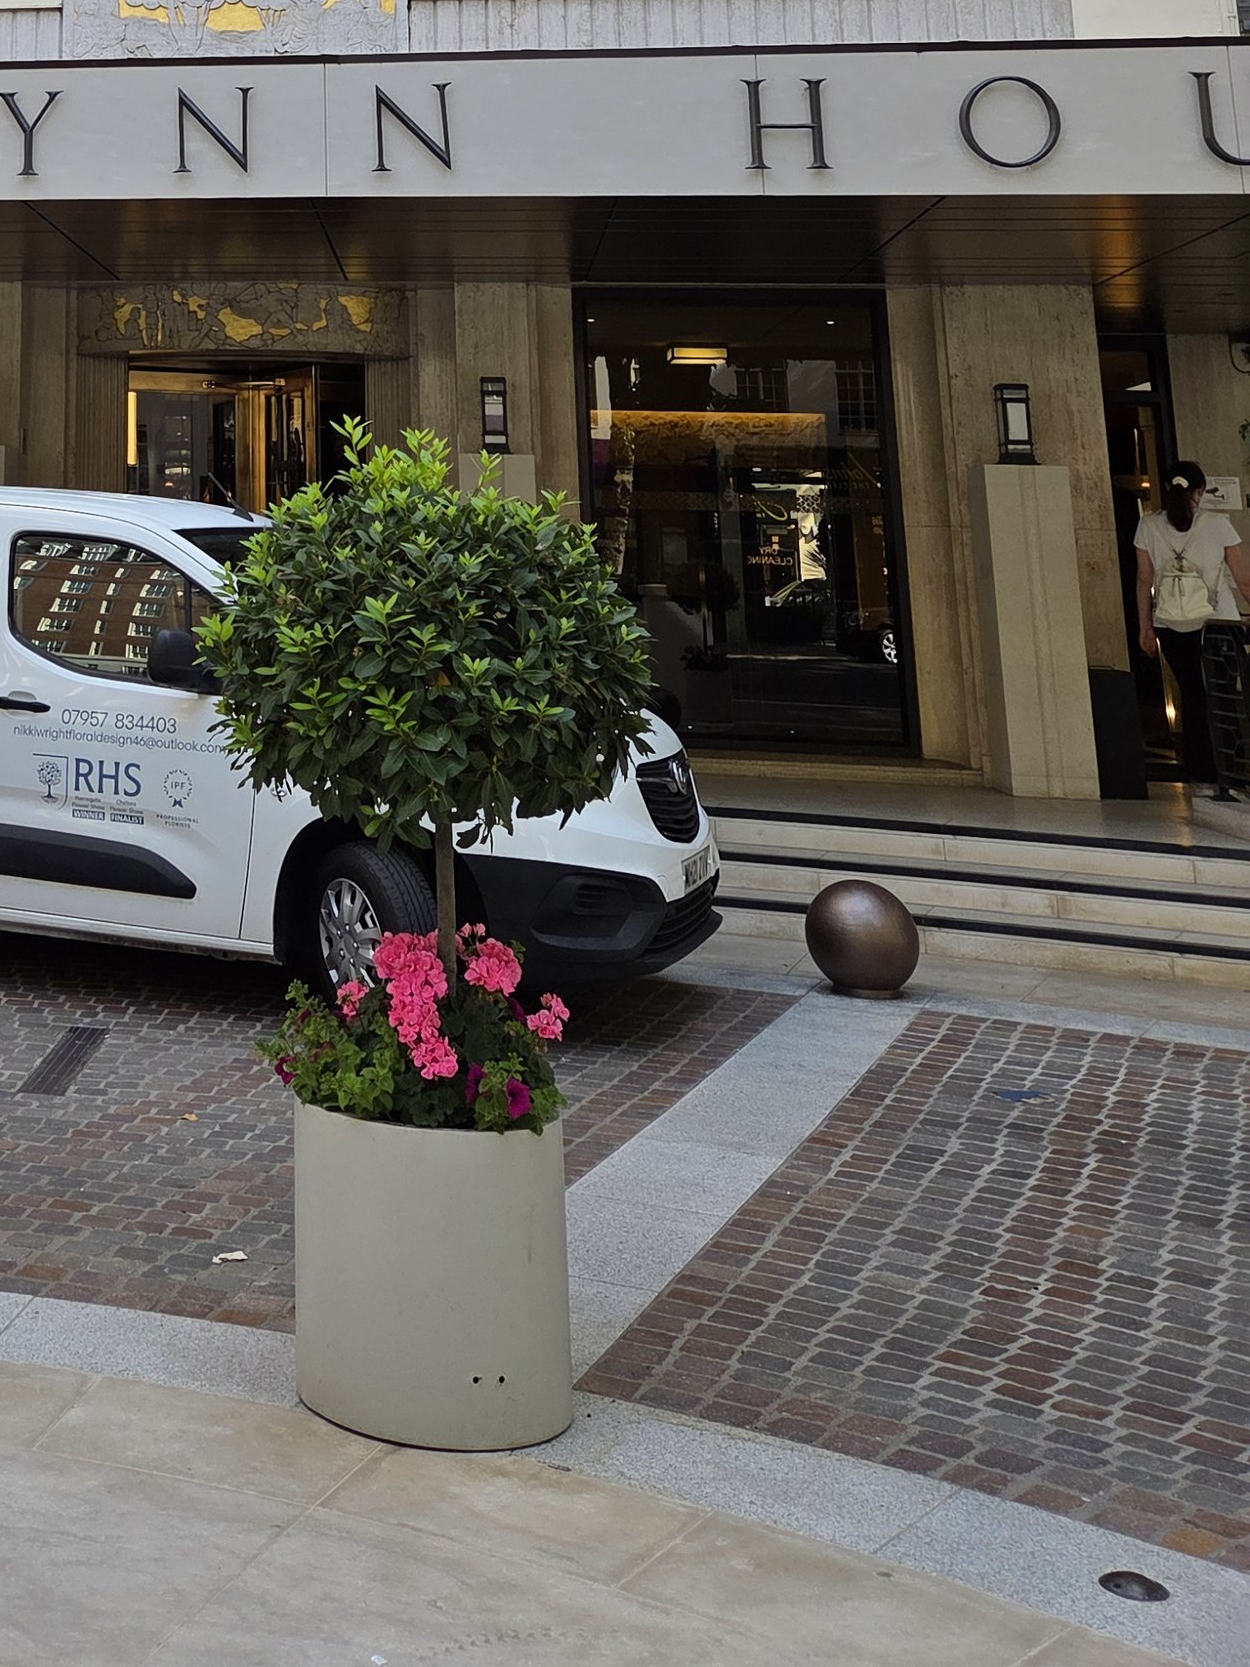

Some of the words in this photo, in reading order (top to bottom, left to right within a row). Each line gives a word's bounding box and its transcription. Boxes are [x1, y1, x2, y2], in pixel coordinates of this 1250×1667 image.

[61, 708, 108, 727] 07957
[114, 713, 177, 734] 834403
[74, 758, 142, 797] RHS
[170, 781, 187, 791] IPF
[73, 810, 104, 820] WINNER
[111, 814, 143, 824] FINALIST
